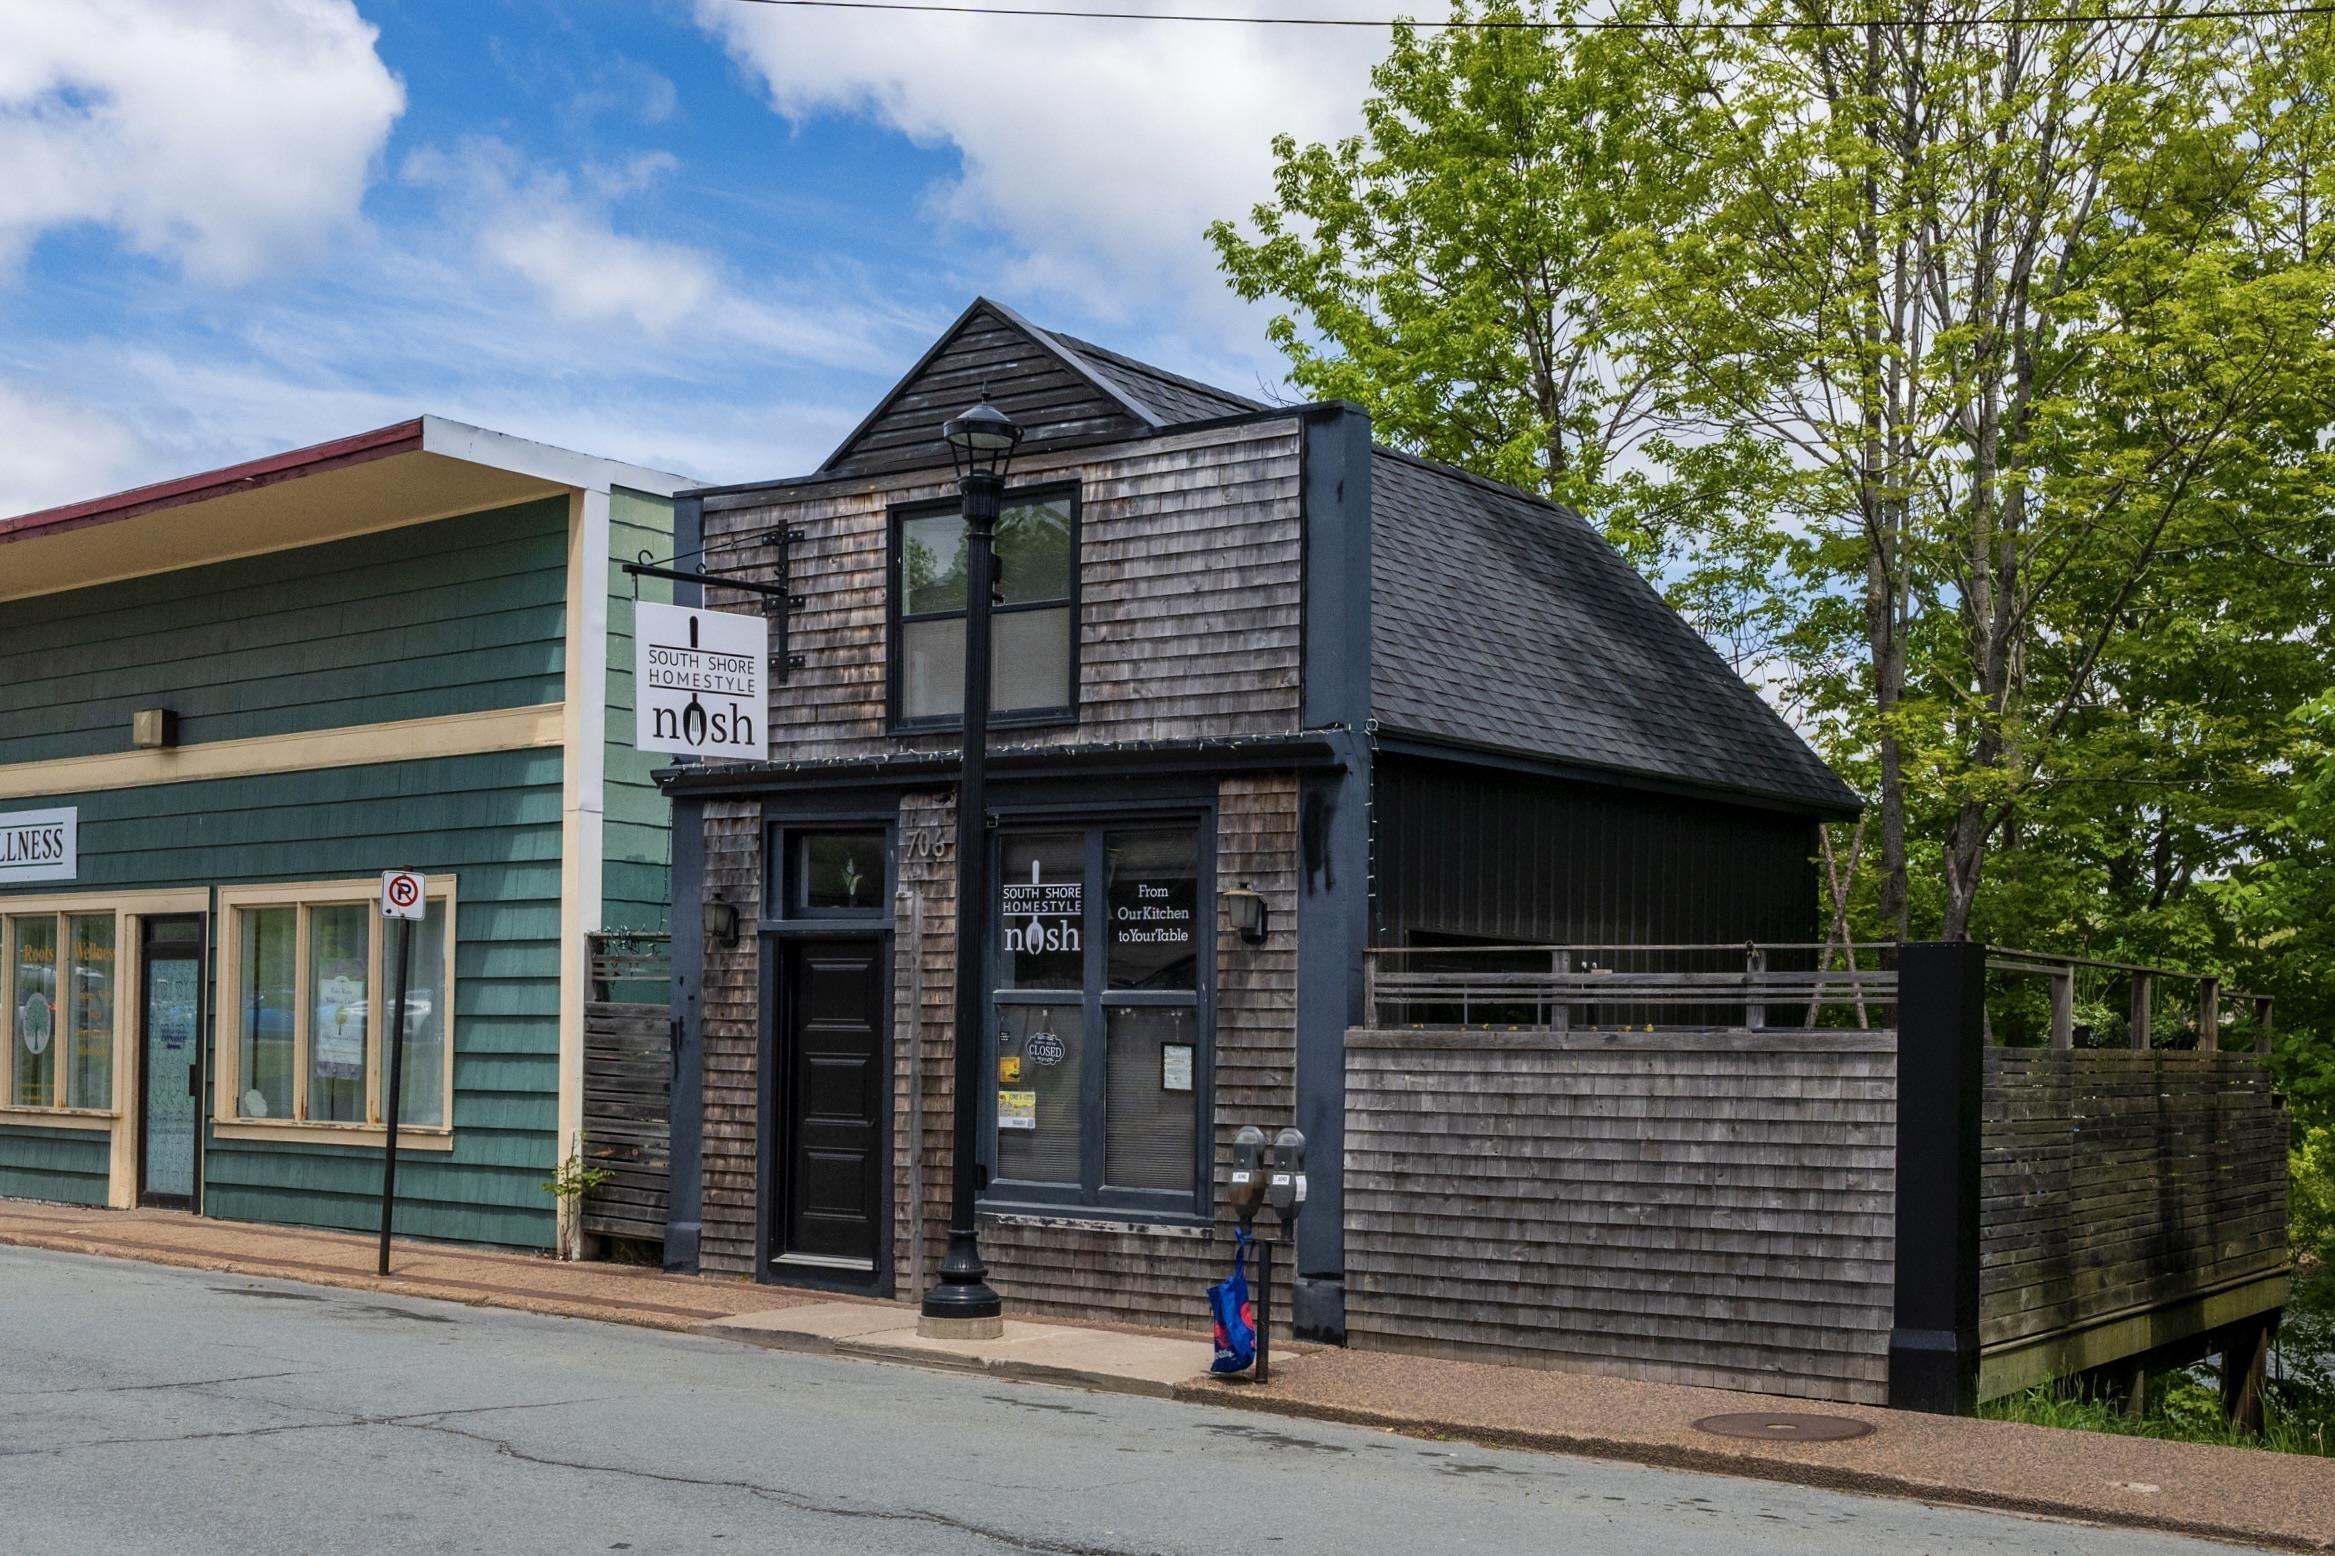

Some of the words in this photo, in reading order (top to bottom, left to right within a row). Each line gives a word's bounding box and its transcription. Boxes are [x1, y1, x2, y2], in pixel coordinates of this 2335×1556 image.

[648, 650, 699, 668] SOUTH
[708, 656, 755, 675] SHORE
[649, 670, 755, 693] HOMESTYLE
[652, 701, 756, 746] nosh
[906, 828, 945, 857] 706
[398, 883, 411, 900] P
[1003, 888, 1039, 899] SOUTH
[1045, 887, 1081, 898] SHORE
[1138, 884, 1168, 898] From
[1003, 901, 1081, 912] HOMESTYLE
[1117, 906, 1142, 920] Our
[1143, 906, 1189, 920] Kitchen
[1004, 919, 1081, 955] nosh
[1118, 930, 1130, 942] to
[1129, 928, 1156, 942] Your
[1155, 928, 1189, 942] Table
[24, 944, 55, 962] Roots
[76, 942, 115, 961] Wellnes
[1029, 1044, 1062, 1058] CLOSED
